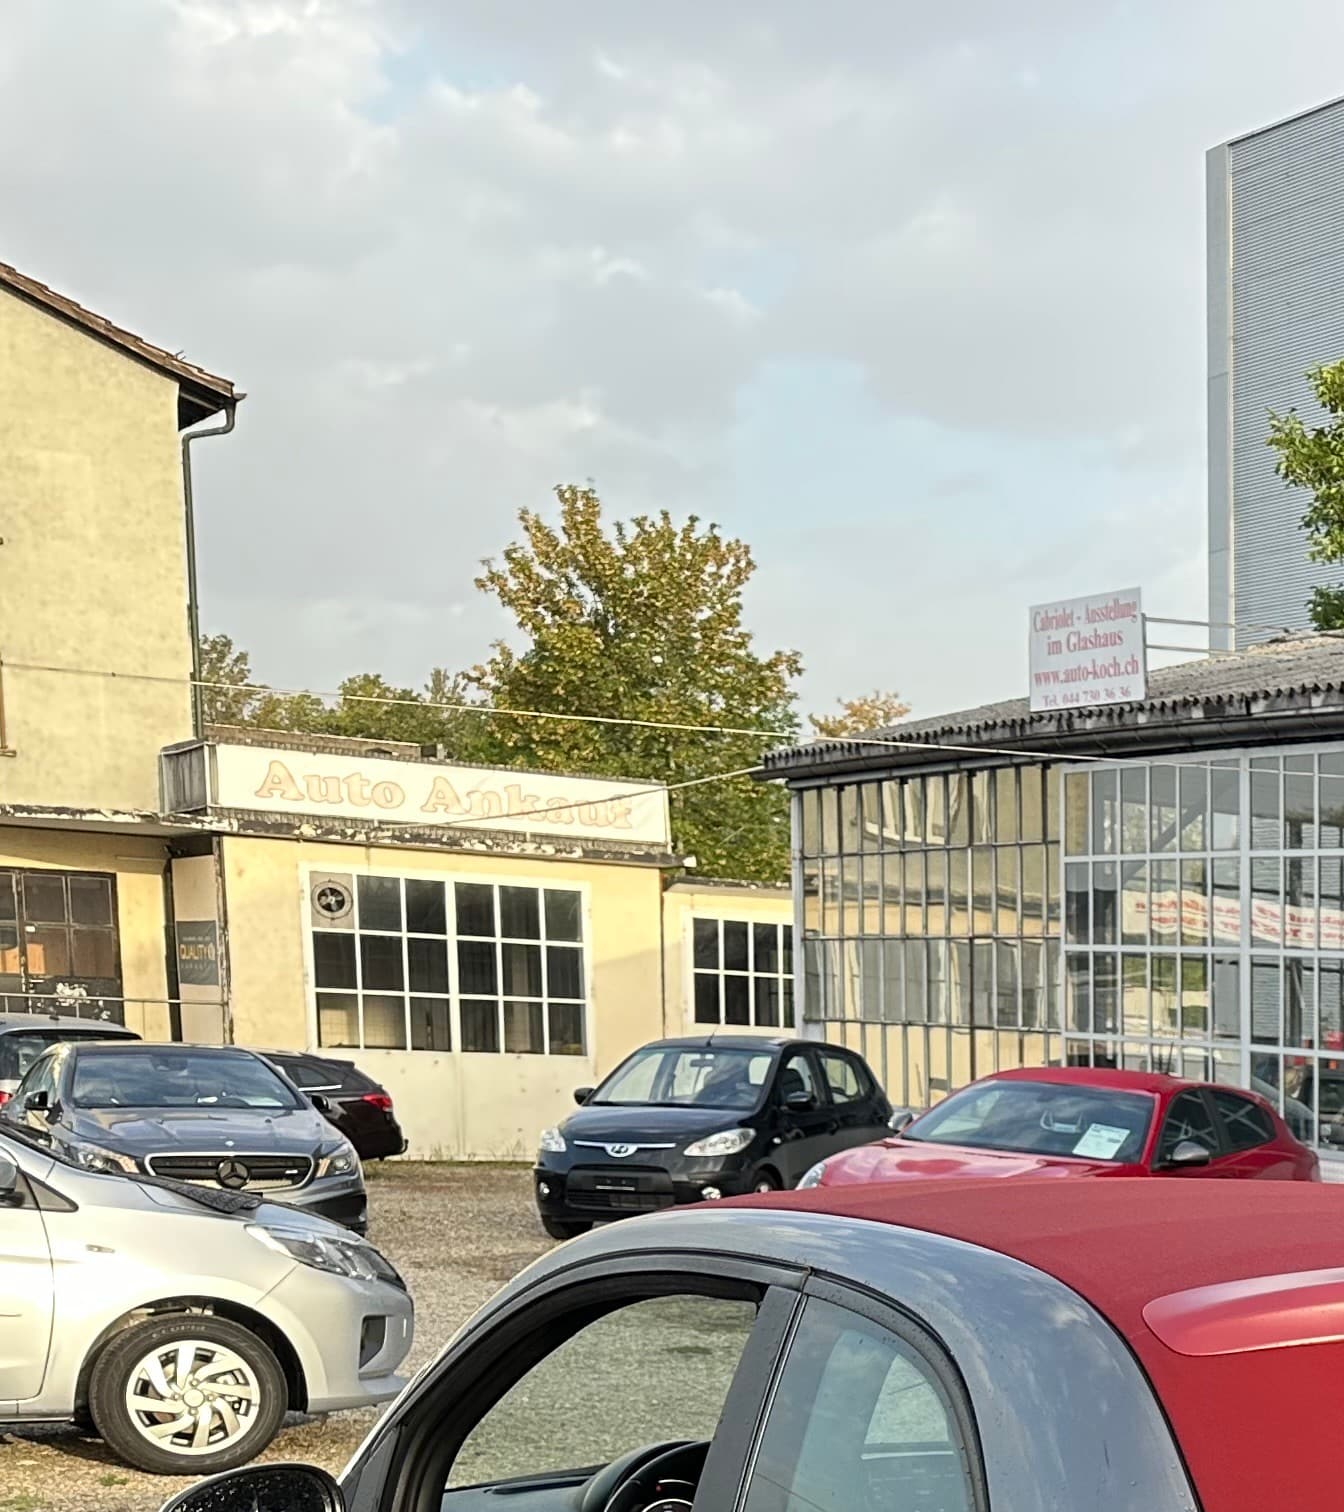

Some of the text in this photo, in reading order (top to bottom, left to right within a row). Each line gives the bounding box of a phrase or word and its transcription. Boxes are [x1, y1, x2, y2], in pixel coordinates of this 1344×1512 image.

[1047, 628, 1124, 655] im Glashaus
[1034, 654, 1139, 687] www.auto-koch.ch
[254, 760, 633, 829] Auto Ankauf
